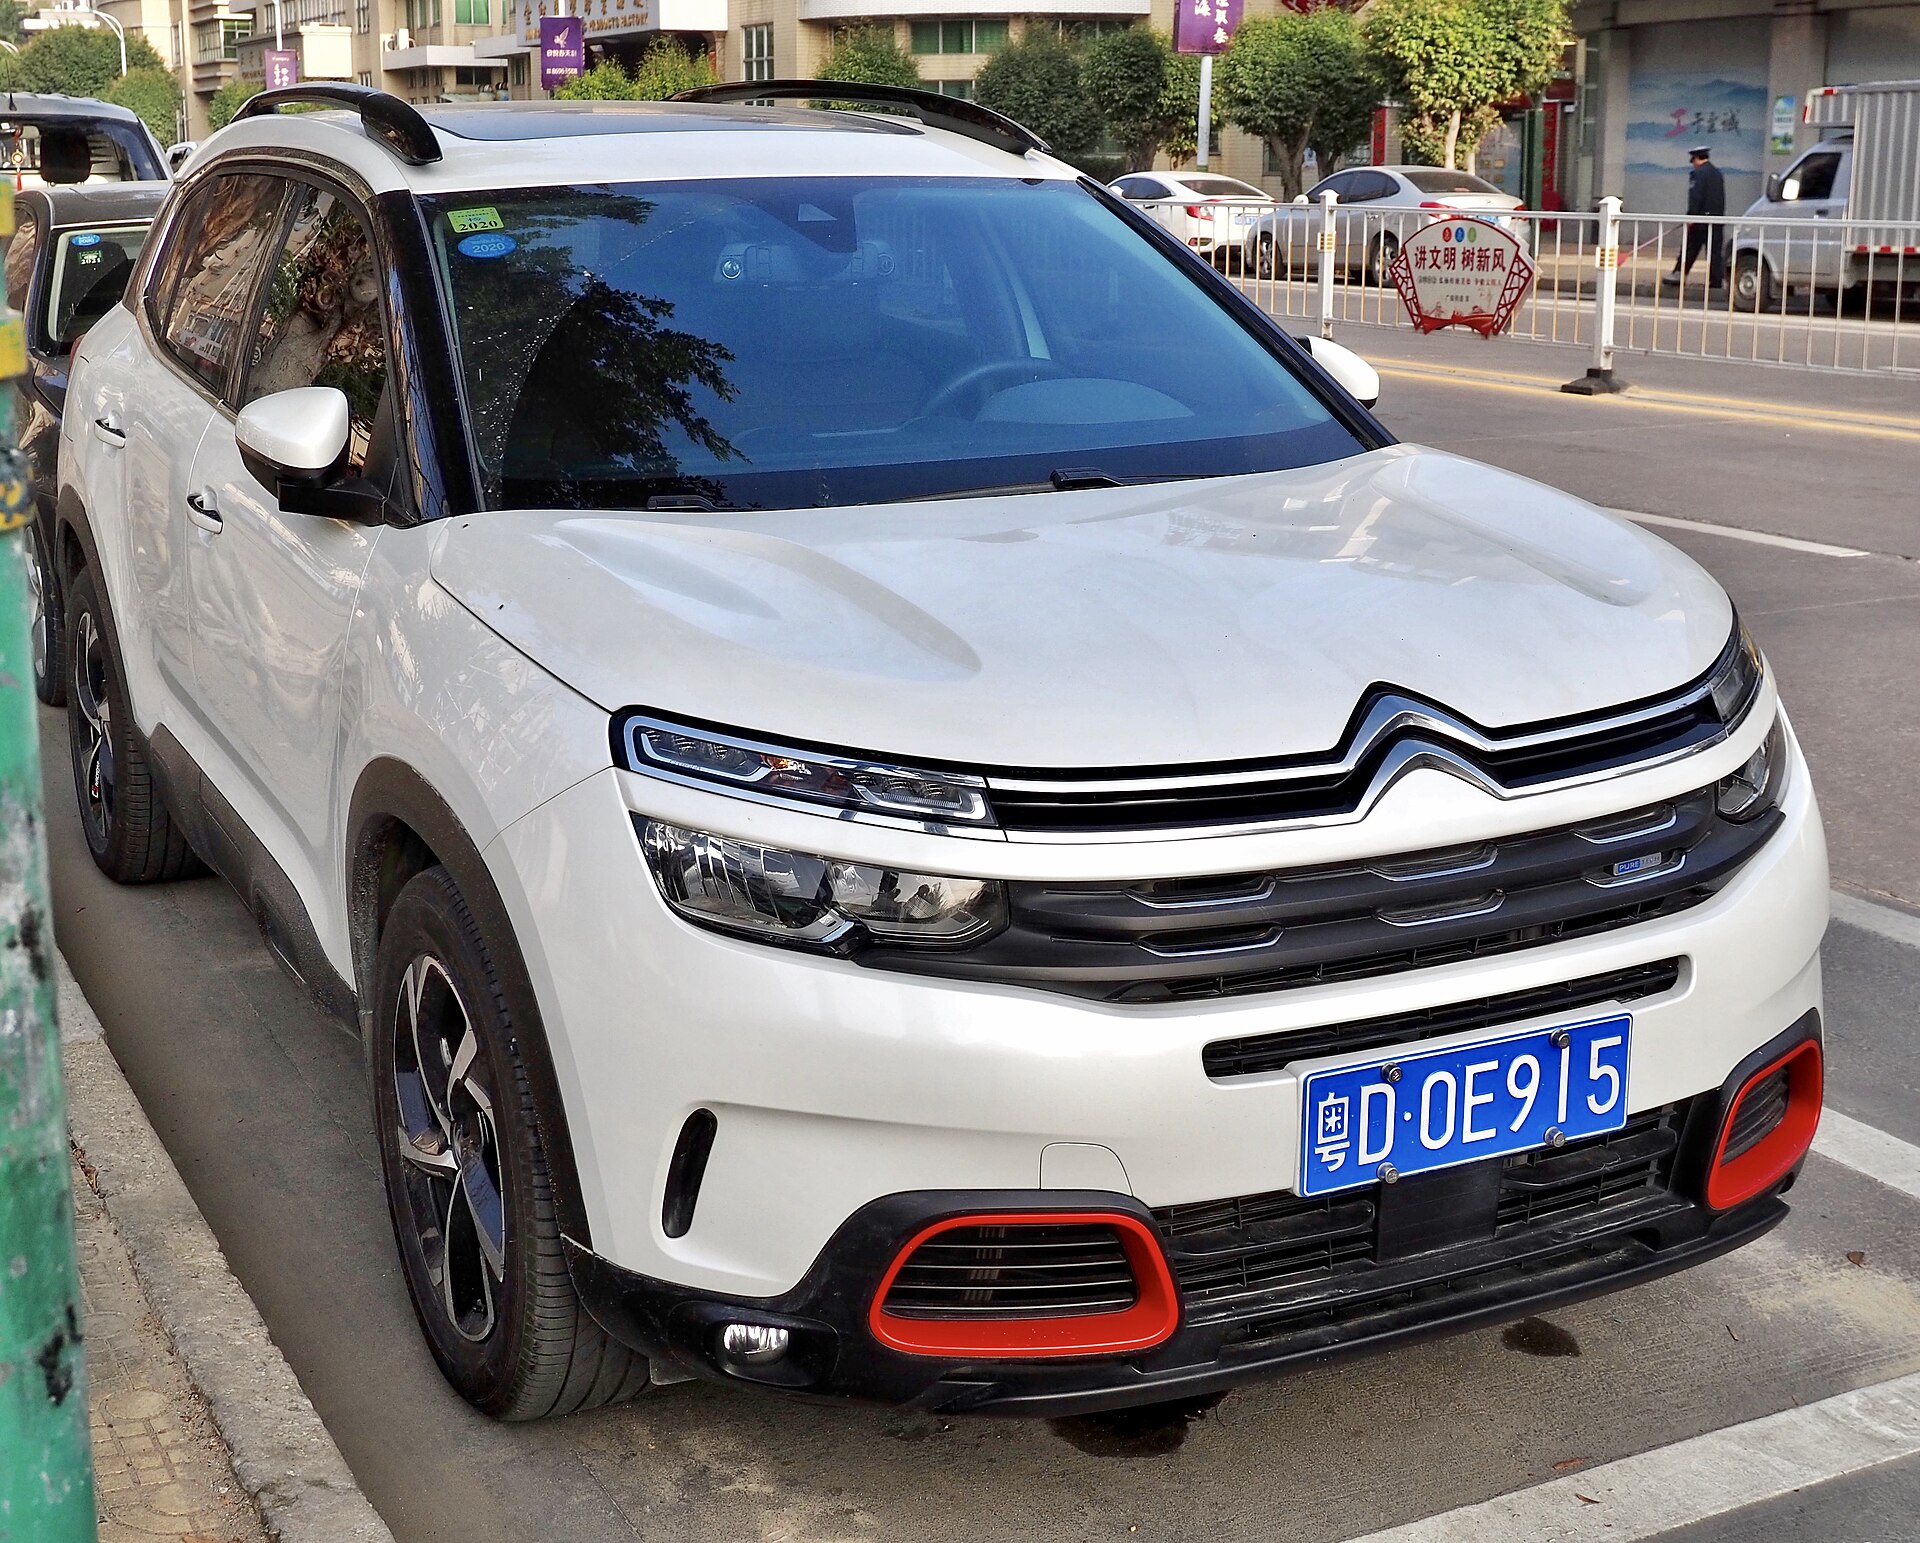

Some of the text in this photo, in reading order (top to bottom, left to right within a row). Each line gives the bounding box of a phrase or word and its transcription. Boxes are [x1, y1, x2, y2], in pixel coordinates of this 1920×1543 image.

[458, 220, 498, 231] 2020
[472, 242, 505, 253] 2020
[1414, 246, 1506, 272] 讲文明 树新风
[1619, 860, 1640, 872] PURE
